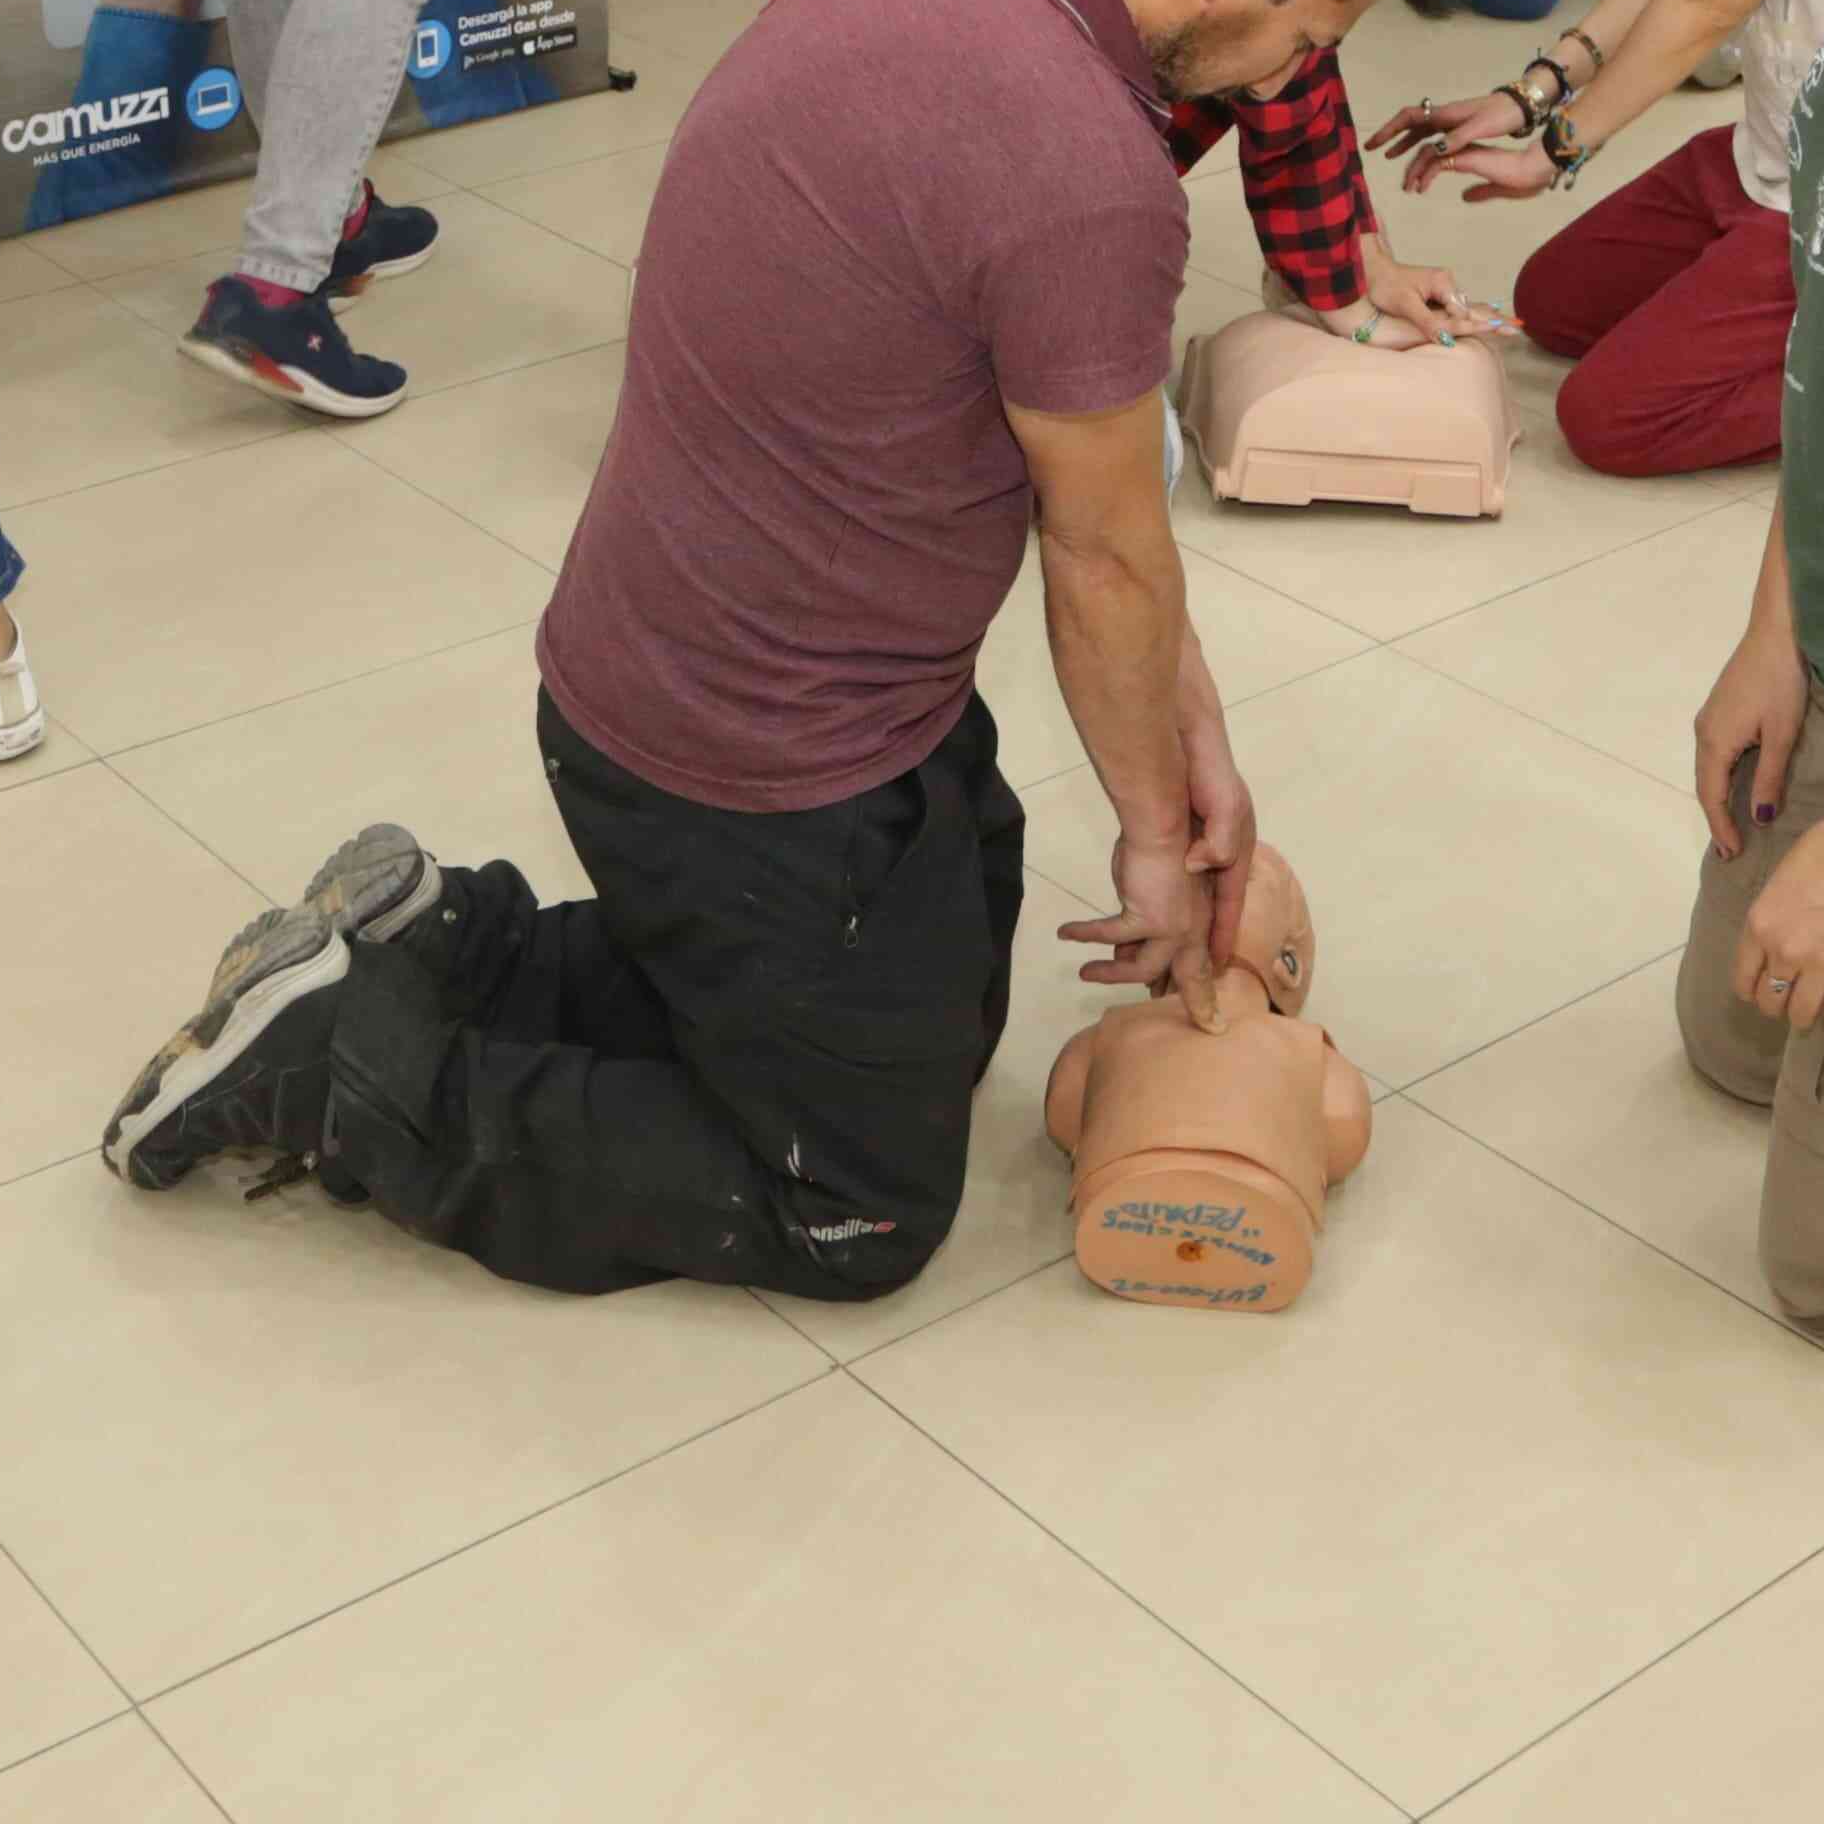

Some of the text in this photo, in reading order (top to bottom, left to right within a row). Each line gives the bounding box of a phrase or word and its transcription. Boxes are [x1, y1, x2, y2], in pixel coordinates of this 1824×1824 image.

[458, 0, 554, 30] Descargá la app
[459, 9, 575, 47] Camuzzi Gas desde
[1, 86, 170, 154] camuzzi
[32, 130, 142, 168] MÁS QUE ENERGÍA
